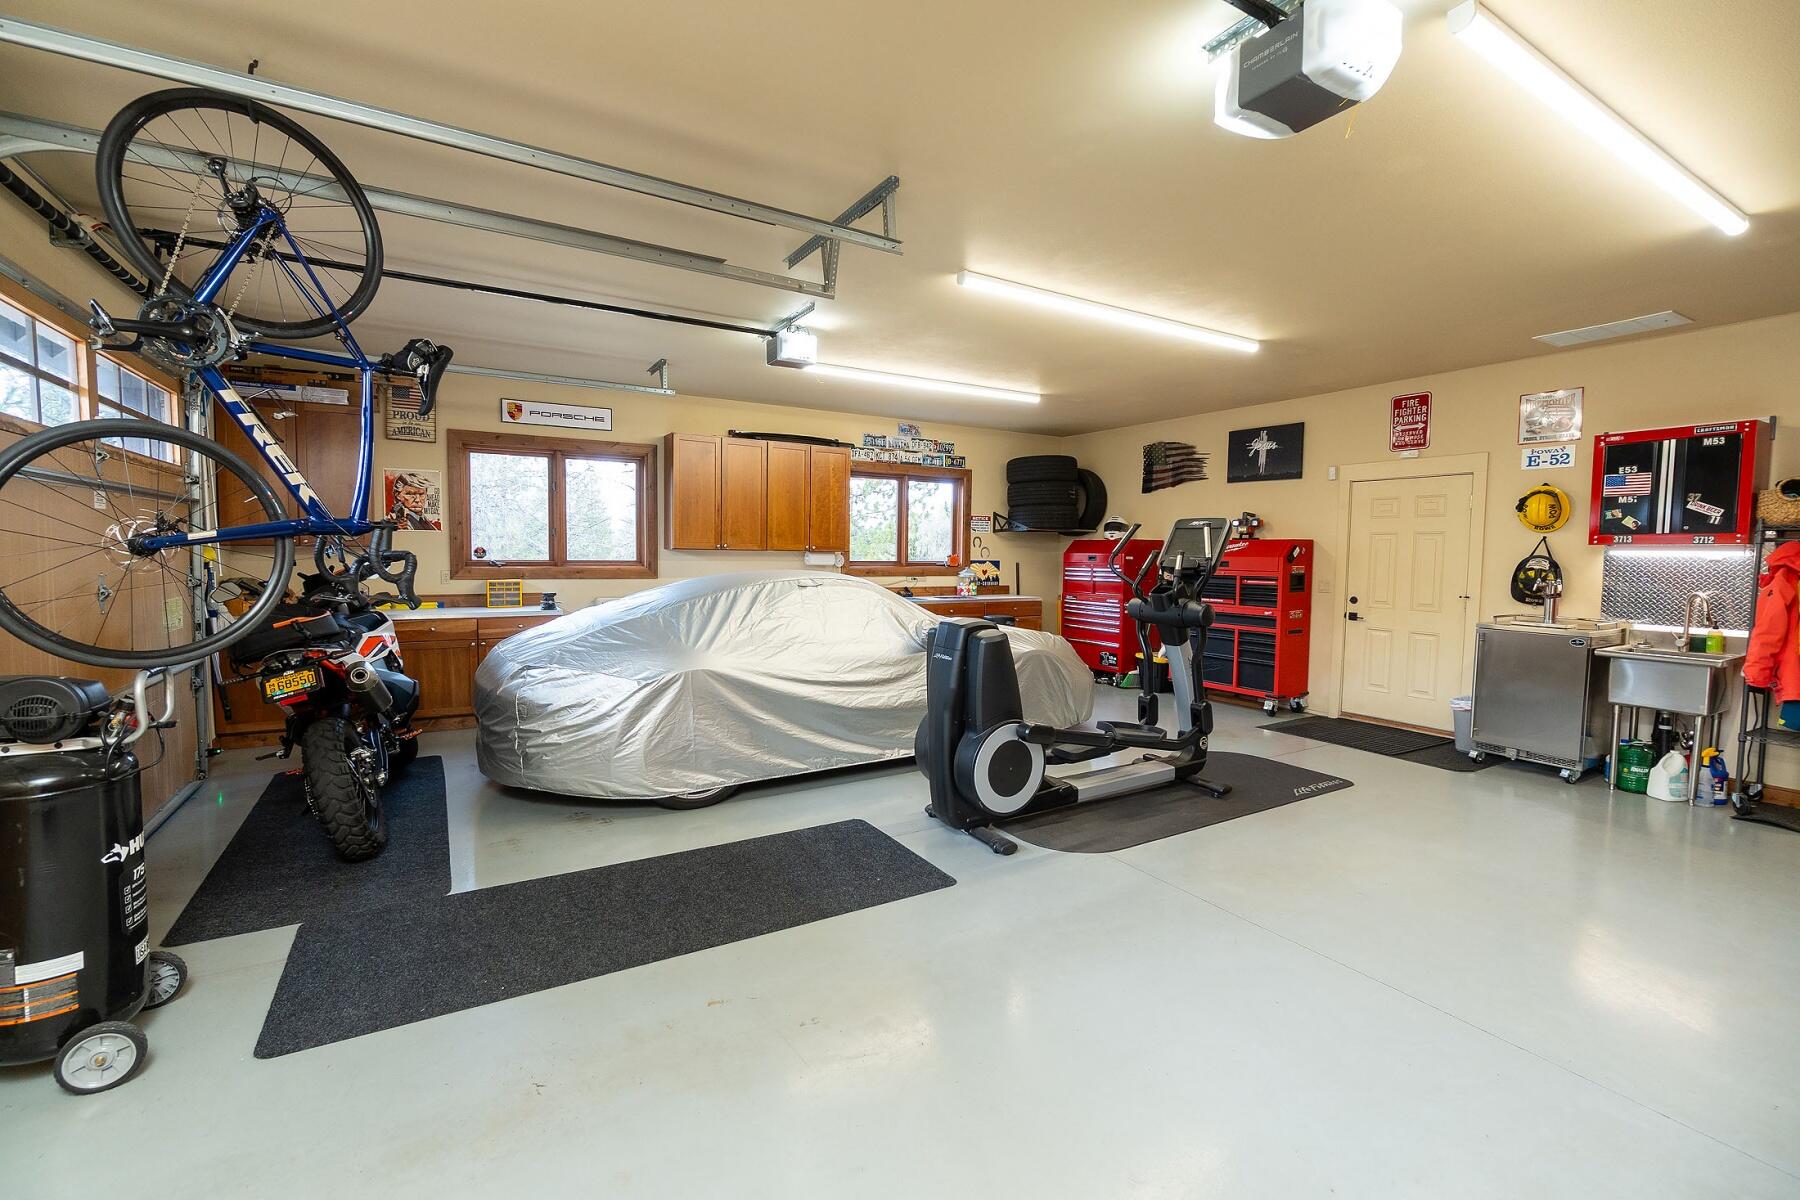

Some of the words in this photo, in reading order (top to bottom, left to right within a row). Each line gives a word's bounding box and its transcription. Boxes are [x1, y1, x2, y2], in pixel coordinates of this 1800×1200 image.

[1402, 399, 1420, 408] FIRE
[529, 410, 605, 423] PORSCHE
[1395, 405, 1427, 417] FIGHTER
[1394, 414, 1427, 424] PARKING
[391, 426, 431, 438] AMERICAN
[218, 377, 320, 506] TREK
[1703, 437, 1725, 446] M53
[1248, 438, 1279, 457] Jesus
[1531, 446, 1567, 456] POWAY
[1526, 452, 1571, 468] E-52
[1619, 466, 1638, 474] E53
[1613, 535, 1633, 543] 3713
[1693, 536, 1715, 544] 3712
[277, 673, 315, 690] 68550
